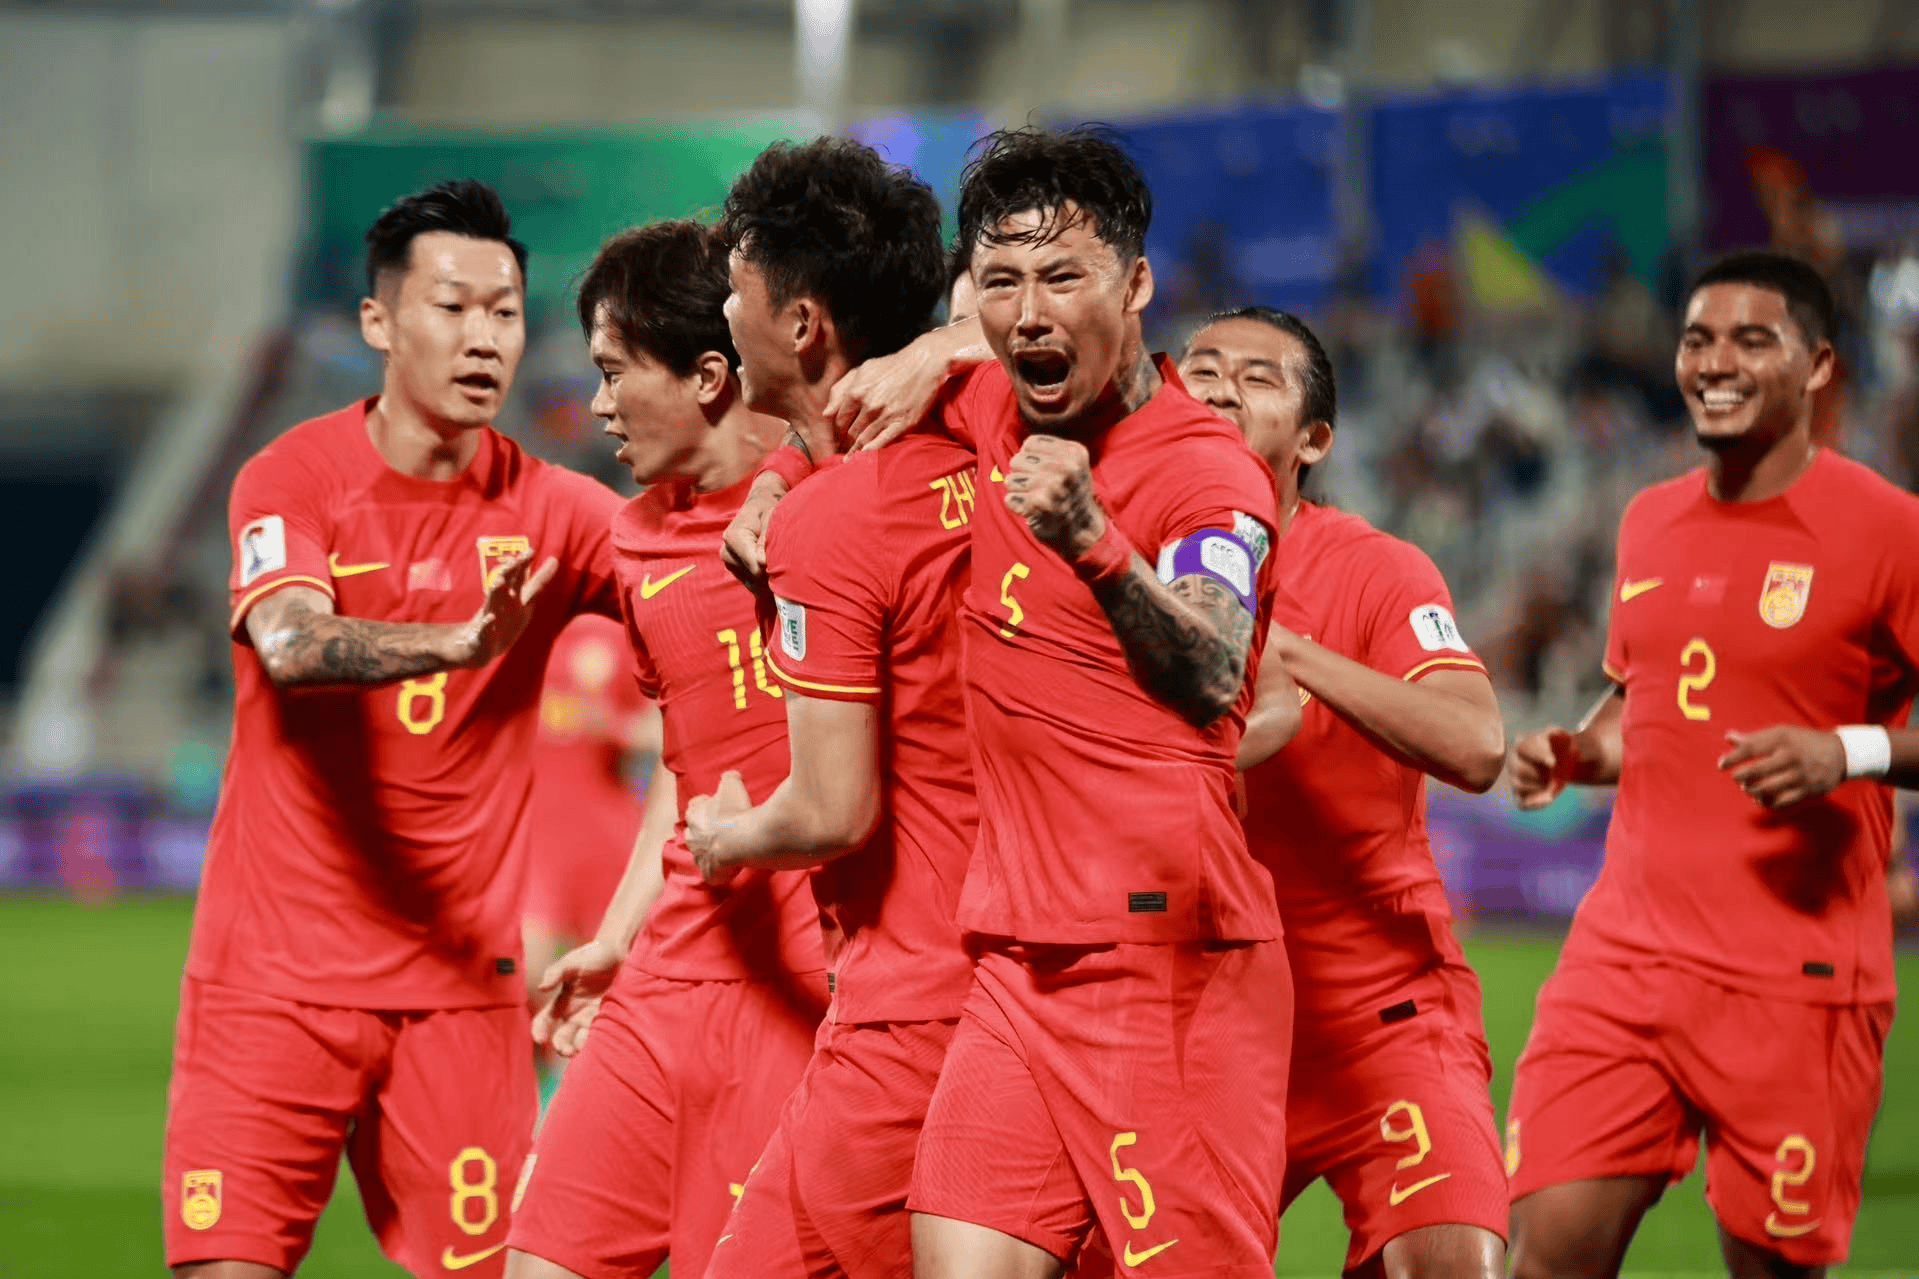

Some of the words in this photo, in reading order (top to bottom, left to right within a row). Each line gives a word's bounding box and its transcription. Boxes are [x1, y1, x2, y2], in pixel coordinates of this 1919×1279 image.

[928, 469, 977, 530] ZH
[1000, 562, 1030, 638] 5
[1677, 636, 1716, 721] 2
[1380, 1099, 1432, 1171] 9
[1771, 1133, 1817, 1215] 2
[449, 1146, 499, 1236] 8
[1110, 1131, 1156, 1230] 5
